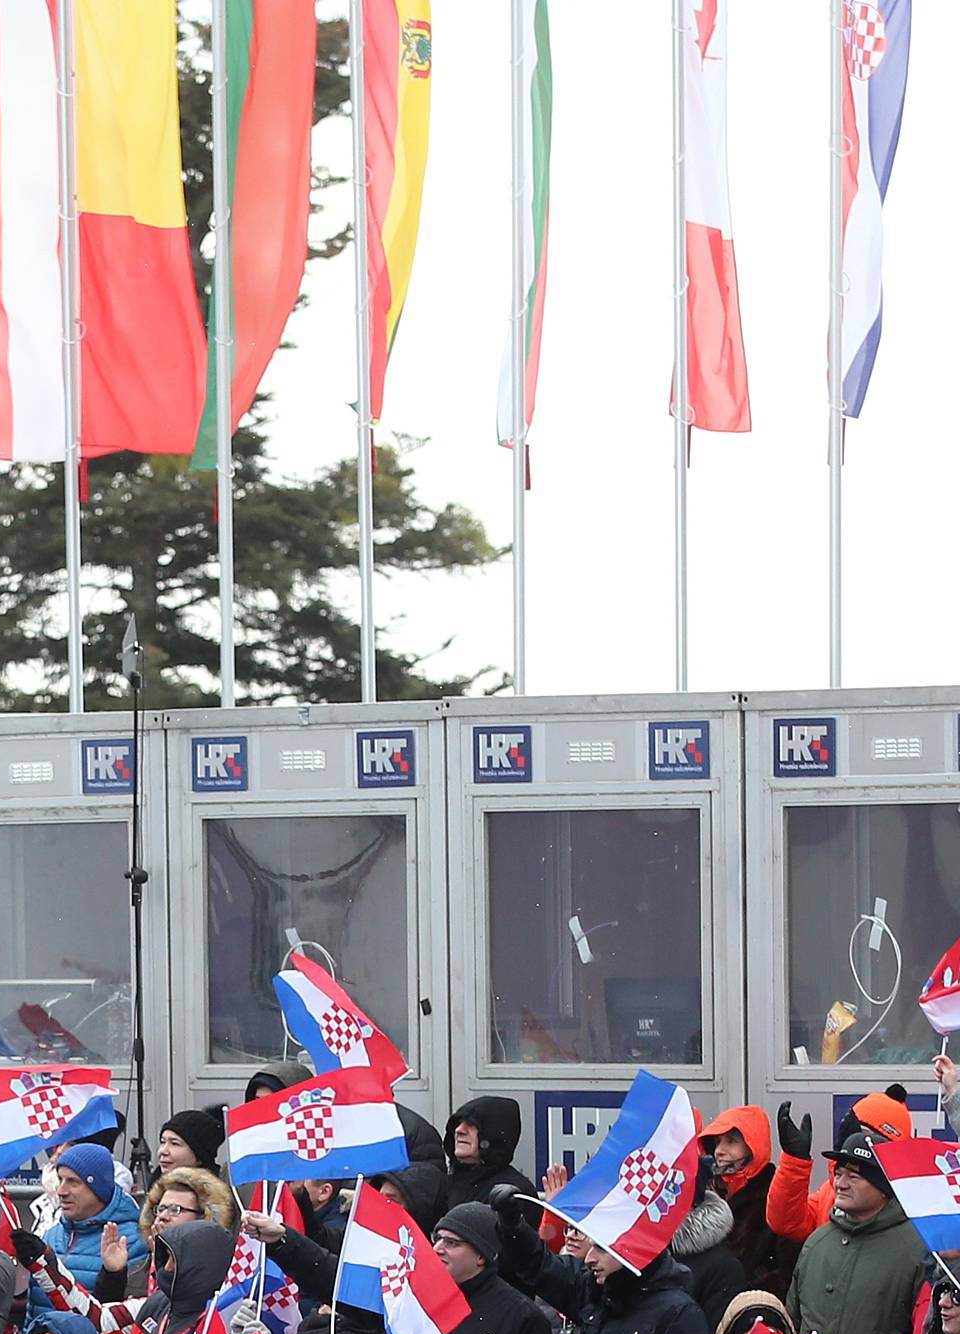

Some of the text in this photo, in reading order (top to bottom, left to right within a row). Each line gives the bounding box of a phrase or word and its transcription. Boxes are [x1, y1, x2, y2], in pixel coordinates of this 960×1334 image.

[362, 738, 409, 773] HRT
[479, 733, 526, 768] HRT
[654, 729, 703, 764] HRT
[780, 725, 828, 761] HRT
[87, 746, 130, 780] HRT
[197, 744, 241, 778] HRT
